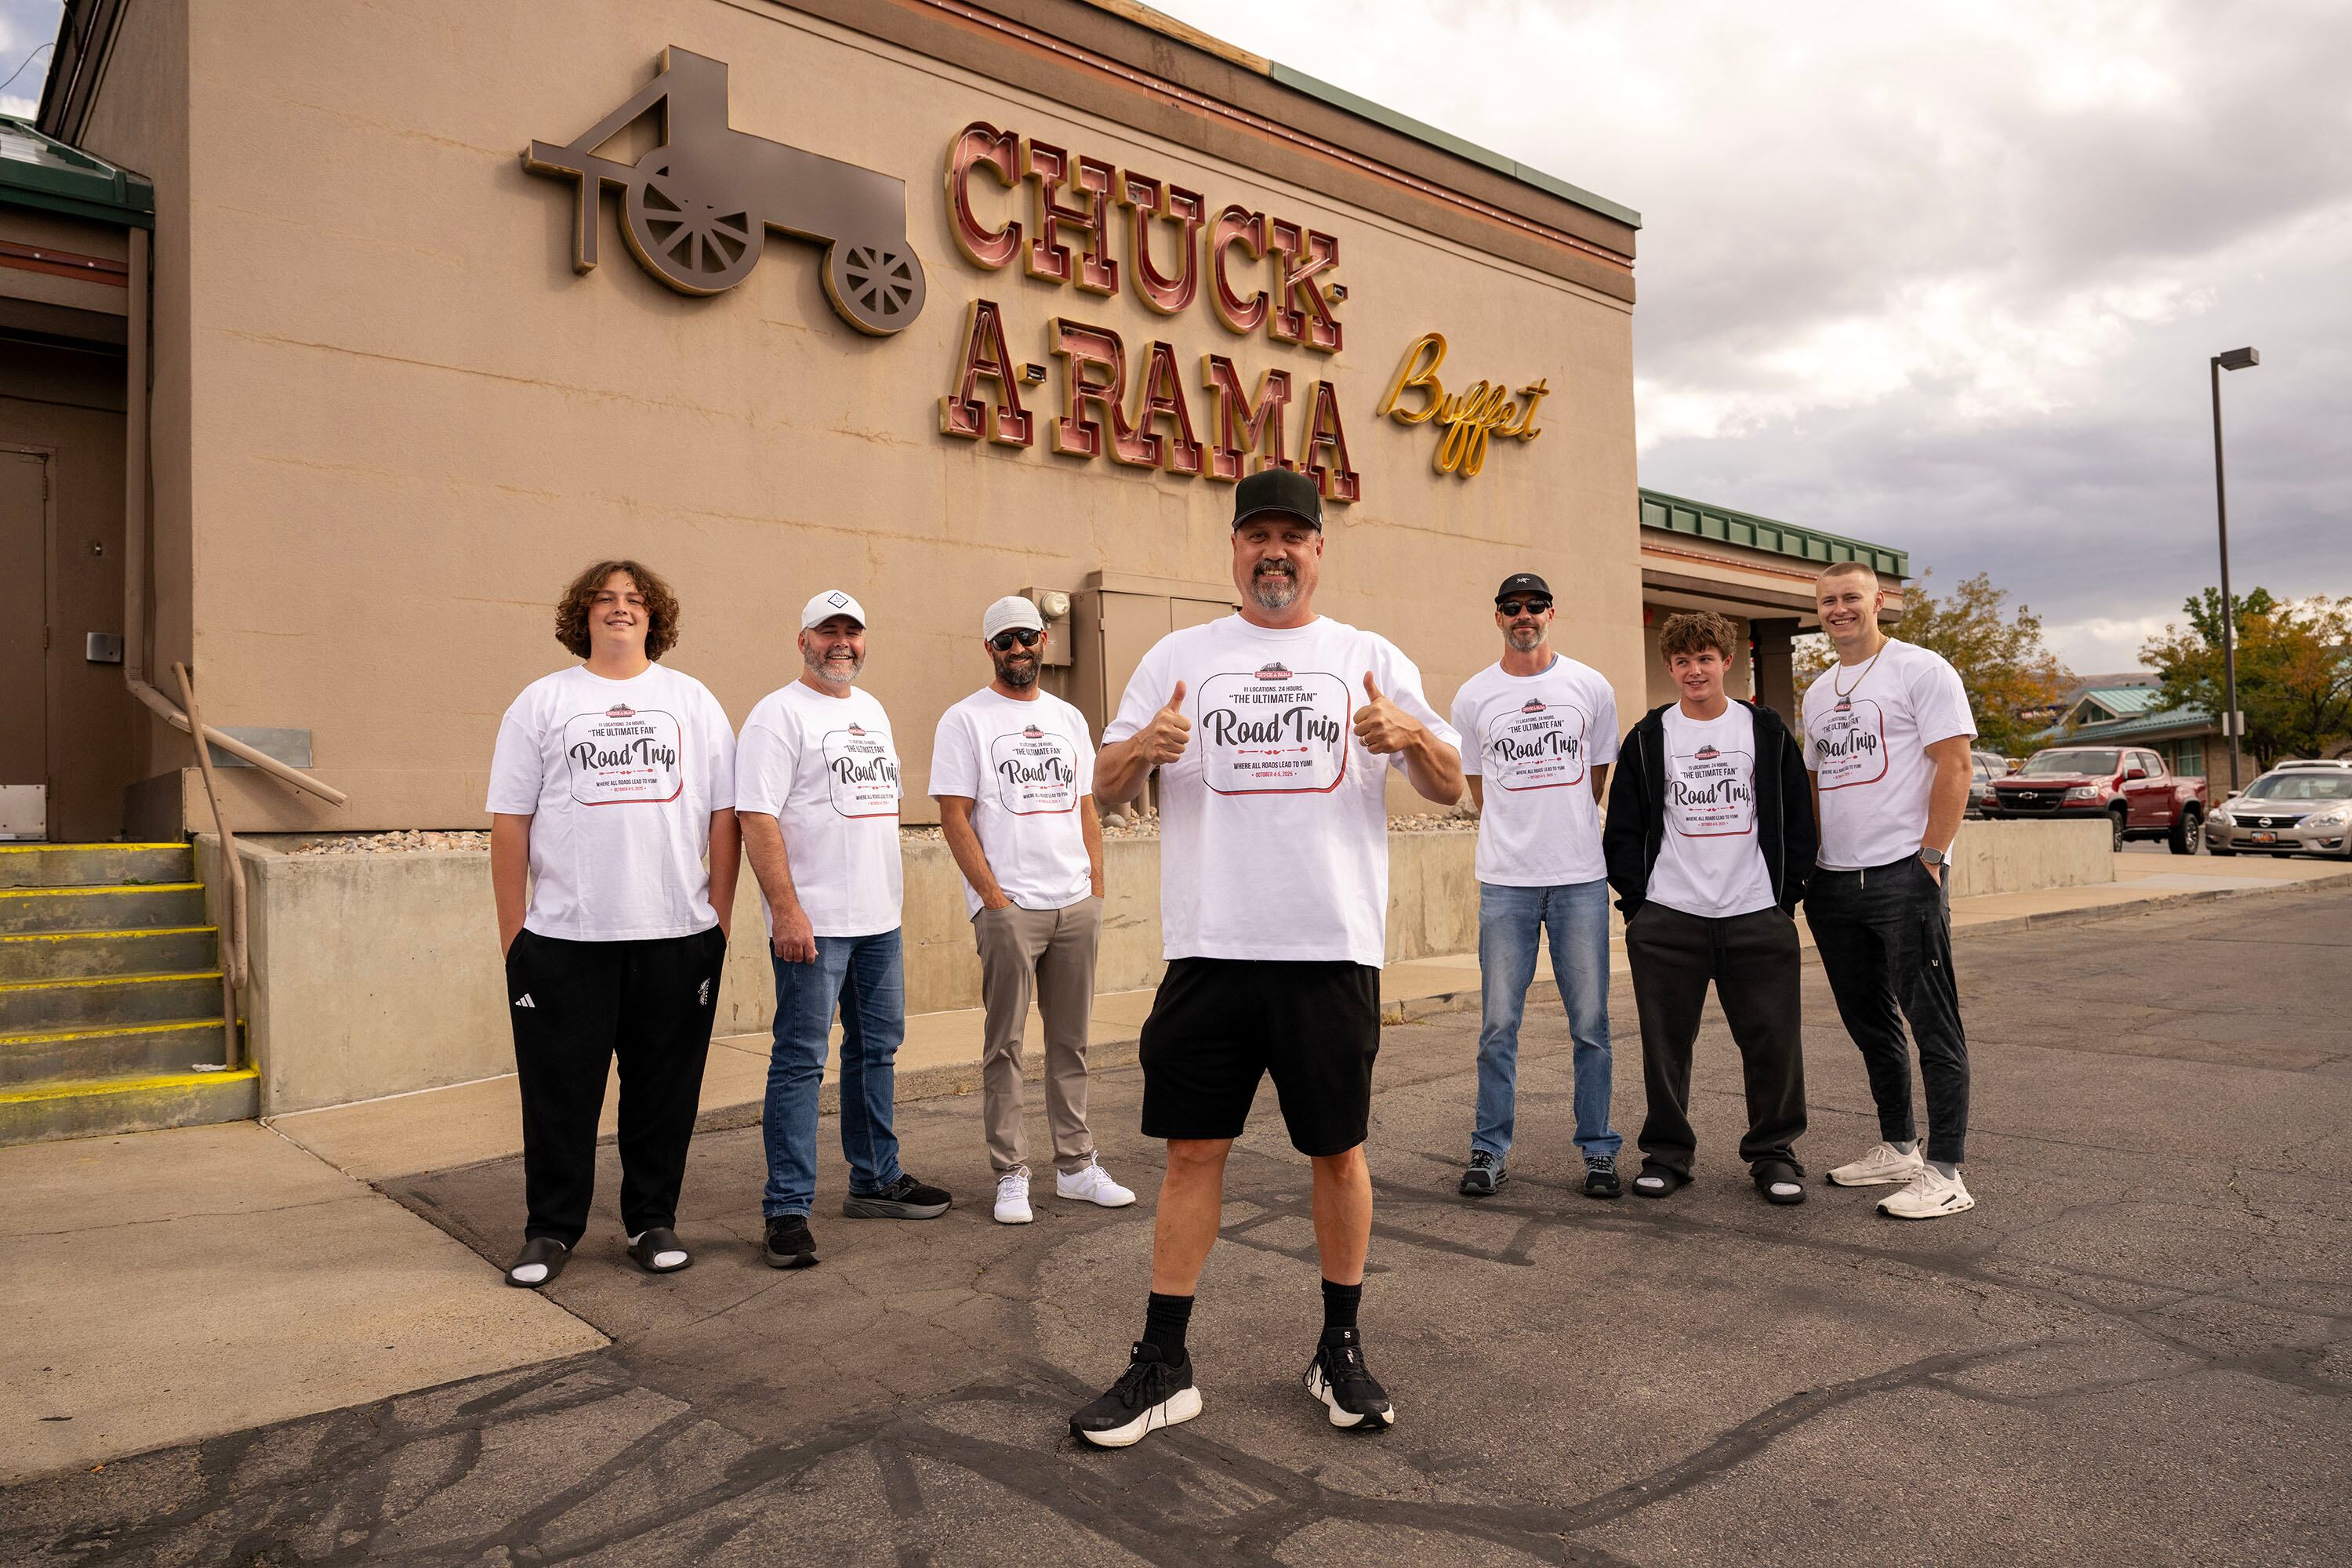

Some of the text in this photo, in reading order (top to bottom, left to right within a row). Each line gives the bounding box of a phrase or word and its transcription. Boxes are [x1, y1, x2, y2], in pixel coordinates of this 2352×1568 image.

[939, 298, 1360, 503] A-RAMA
[1377, 332, 1549, 479] Buffet
[1229, 692, 1317, 703] “THE ULTIMATE FAN”
[588, 728, 604, 737] “THE
[607, 727, 639, 736] ULTIMATE
[1203, 706, 1340, 752] Road Trip
[1523, 721, 1549, 731] ULTIMATE
[569, 738, 676, 772] Road Trip
[1495, 731, 1578, 762] Road Trip
[1847, 728, 1877, 756] Trip
[832, 757, 876, 784] Road
[999, 759, 1047, 784] Road
[1695, 768, 1722, 778] ULTIMATE
[1670, 779, 1751, 808] Road Trip
